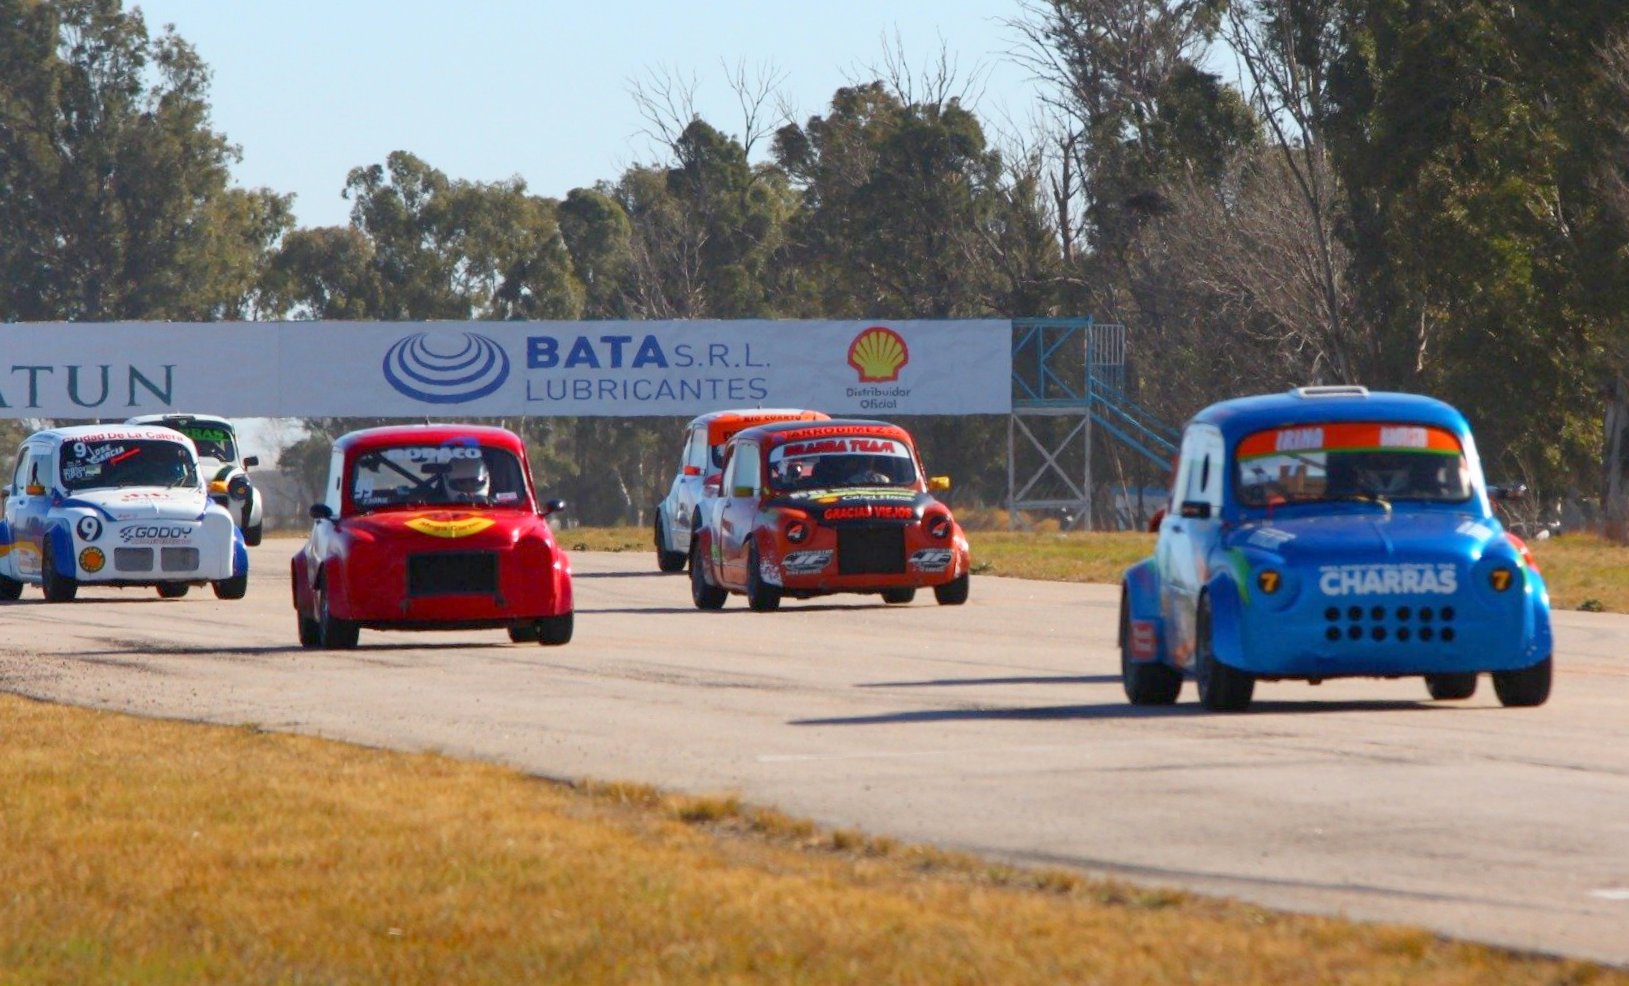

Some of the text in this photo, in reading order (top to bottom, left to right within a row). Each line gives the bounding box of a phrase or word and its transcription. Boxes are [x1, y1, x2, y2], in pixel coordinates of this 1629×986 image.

[527, 335, 771, 369] BATA S.R.L.
[0, 364, 177, 409] TUN
[526, 378, 768, 401] LUBRICANTES
[846, 387, 911, 398] Distribuidor
[860, 399, 897, 409] Oficial
[107, 432, 125, 440] De
[146, 432, 184, 442] Calera
[73, 442, 87, 458] 9
[824, 506, 913, 520] GRACIAS VIEJOS
[81, 516, 98, 541] 9
[136, 526, 192, 538] GODOY
[1260, 573, 1278, 592] 7
[1319, 569, 1458, 596] CHARRAS
[1492, 570, 1510, 590] 7
